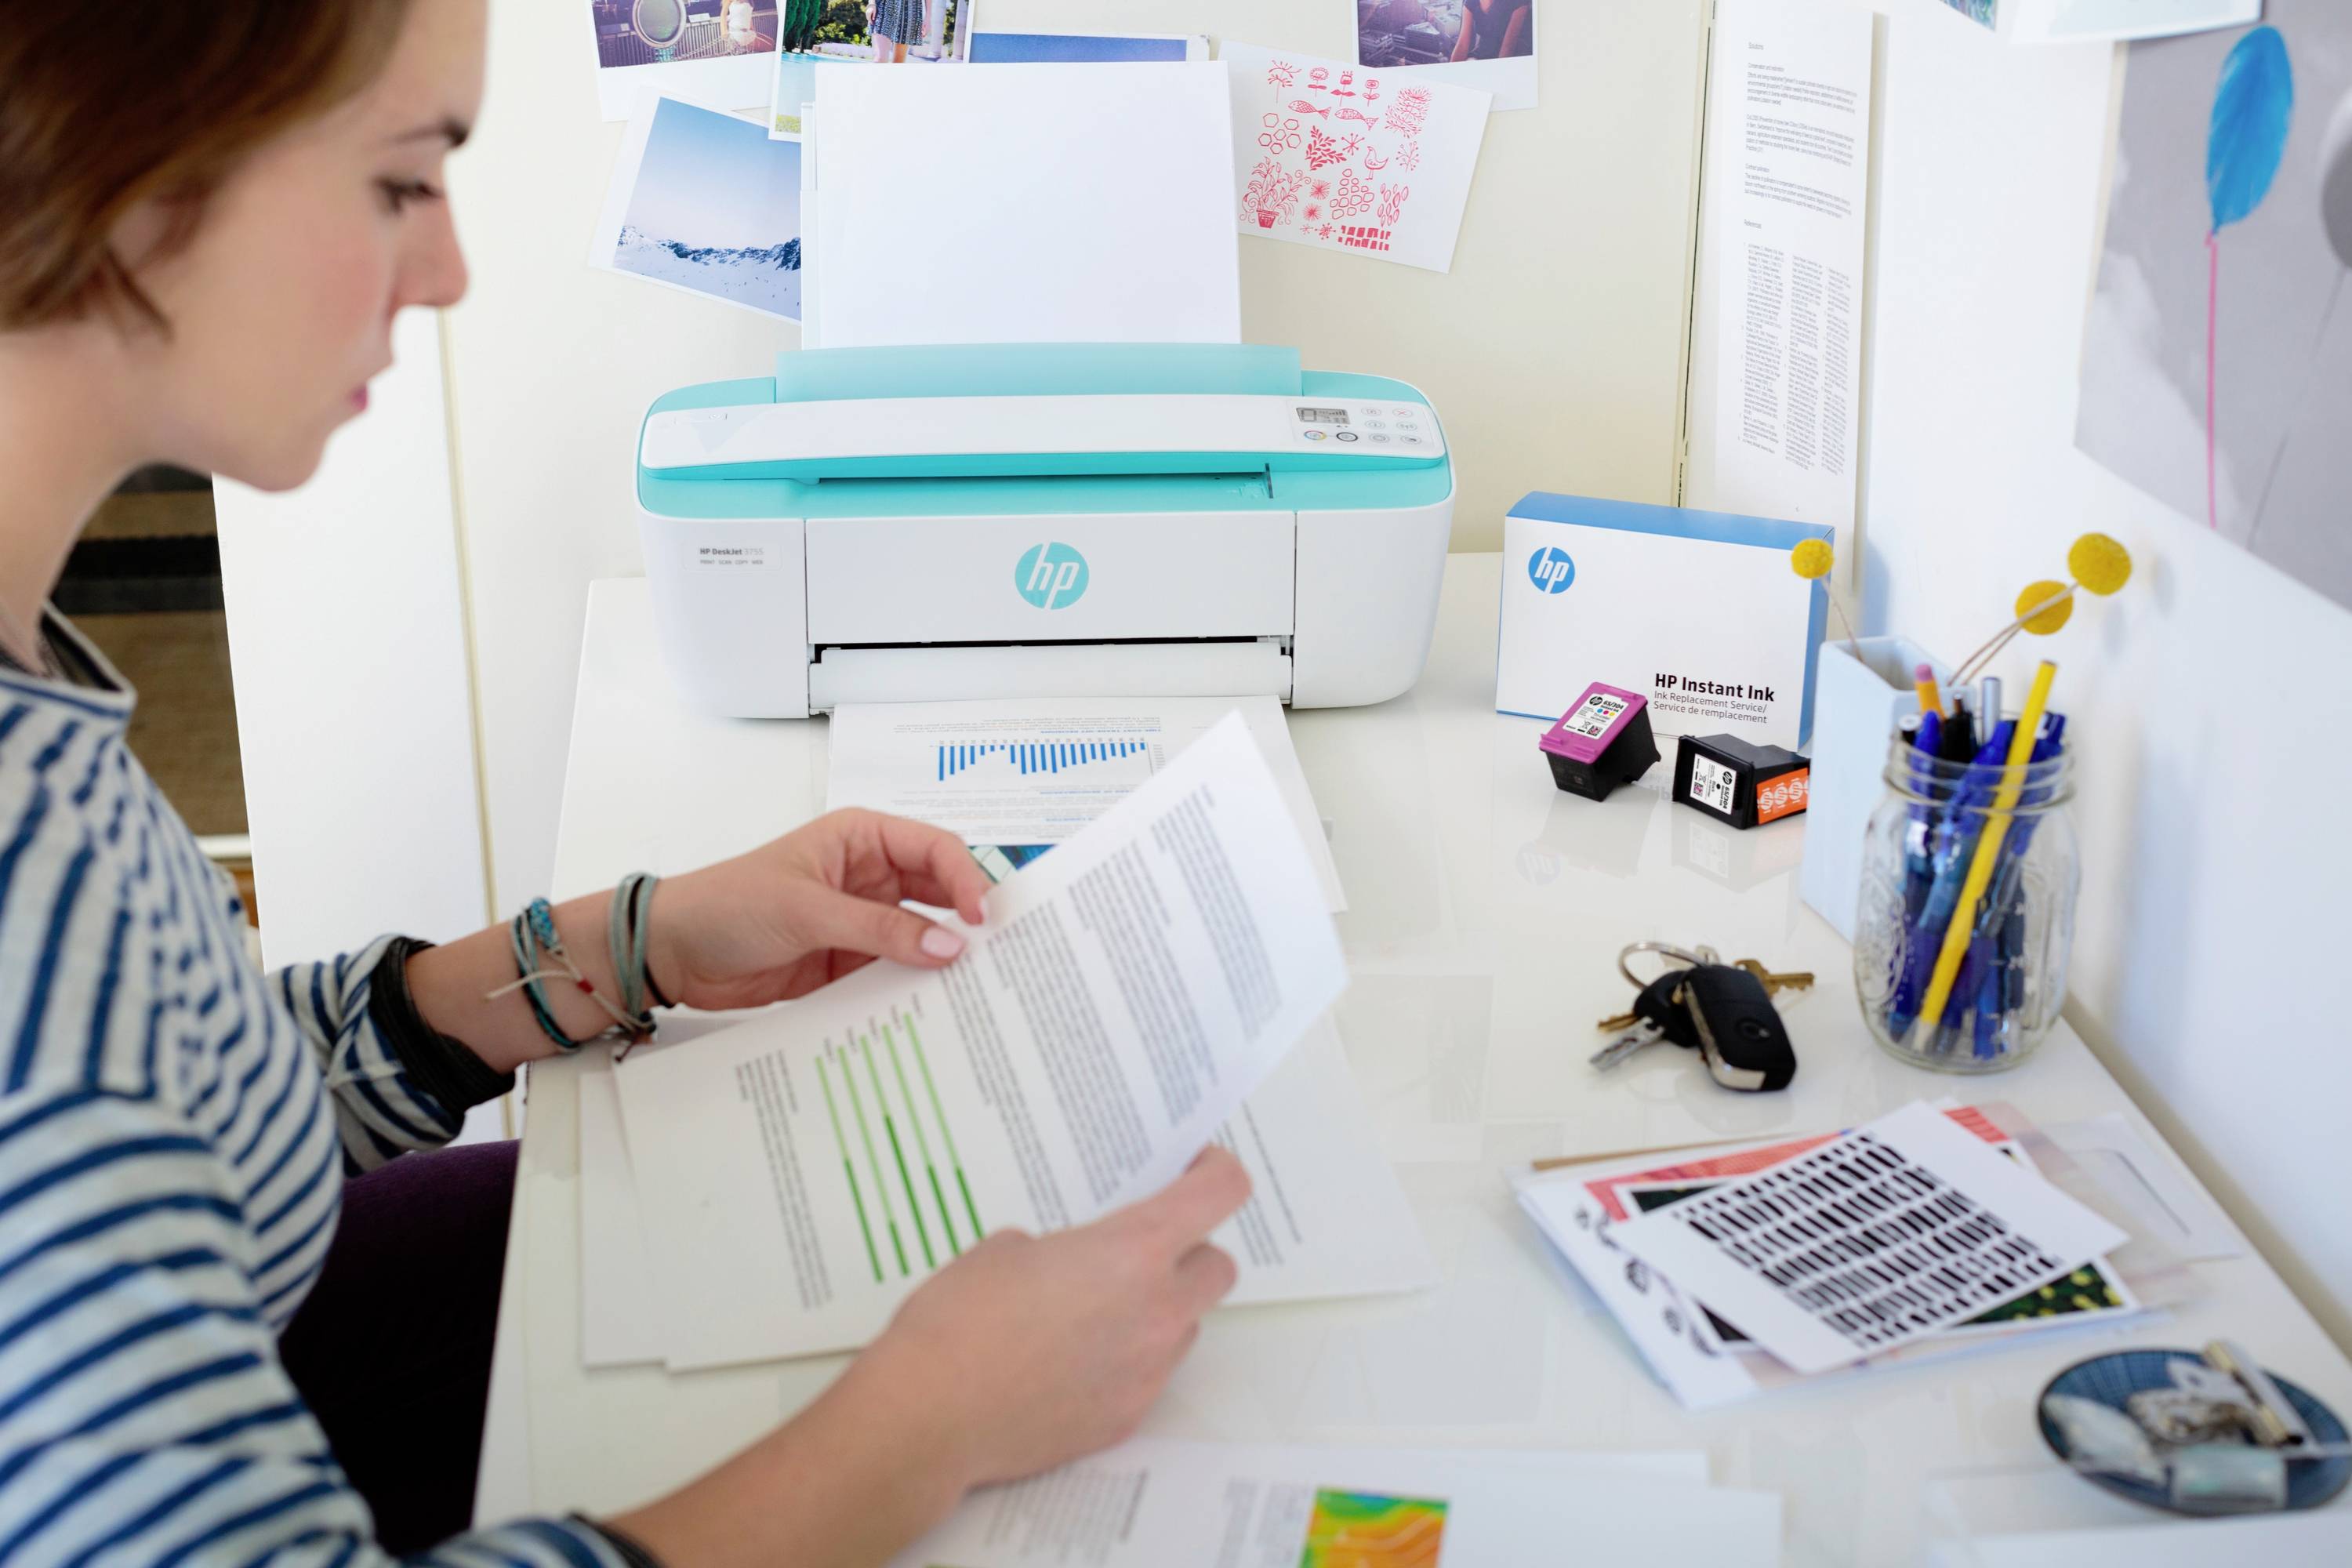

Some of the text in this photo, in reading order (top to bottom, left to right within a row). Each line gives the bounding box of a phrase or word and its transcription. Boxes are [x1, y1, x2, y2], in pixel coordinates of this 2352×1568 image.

[1025, 542, 1080, 609] hp
[1534, 547, 1569, 593] hp
[1654, 690, 1768, 714] Ink Replacement Service/
[1655, 673, 1775, 702] HP Instant Ink
[1653, 700, 1767, 724] Service de remplacement
